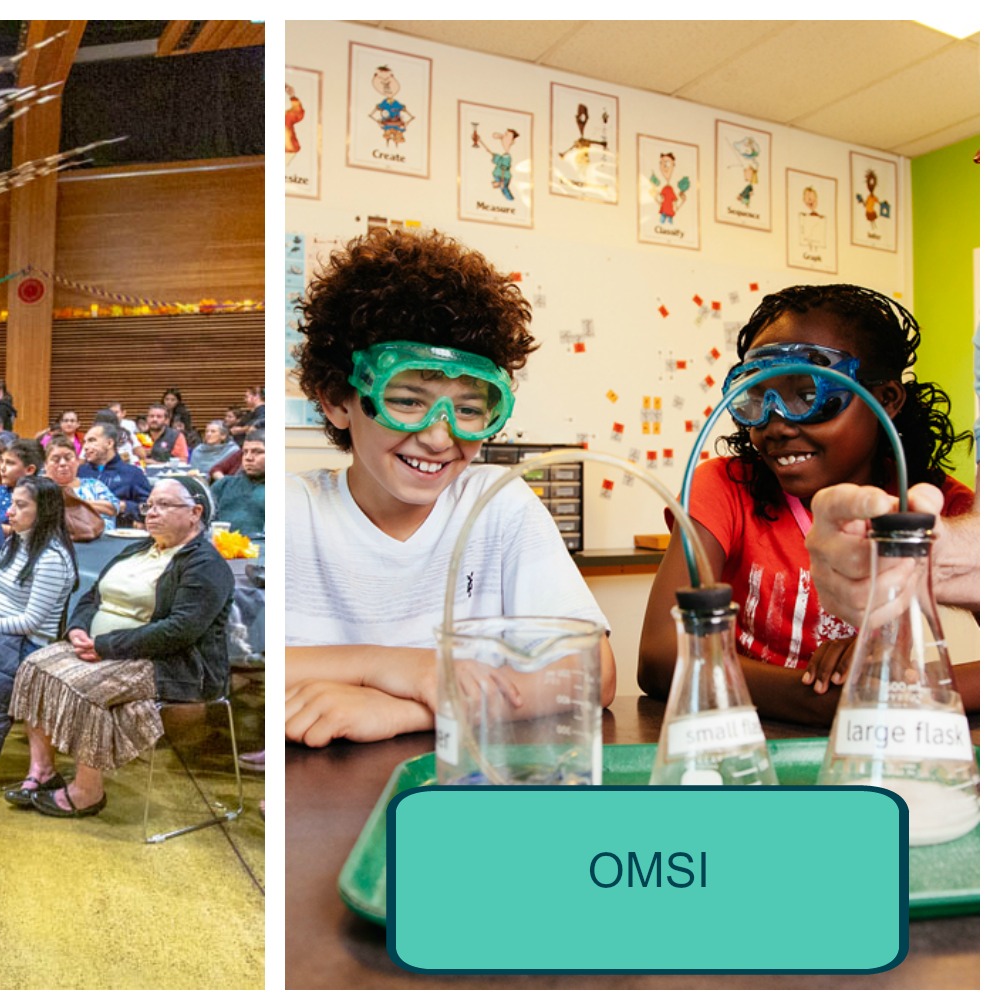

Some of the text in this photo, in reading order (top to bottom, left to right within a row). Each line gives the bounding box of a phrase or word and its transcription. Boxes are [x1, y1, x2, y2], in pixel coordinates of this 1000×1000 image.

[372, 149, 405, 163] Create
[476, 201, 515, 215] Measure
[654, 225, 684, 239] Classify
[686, 721, 738, 743] small
[847, 720, 964, 749] large flask
